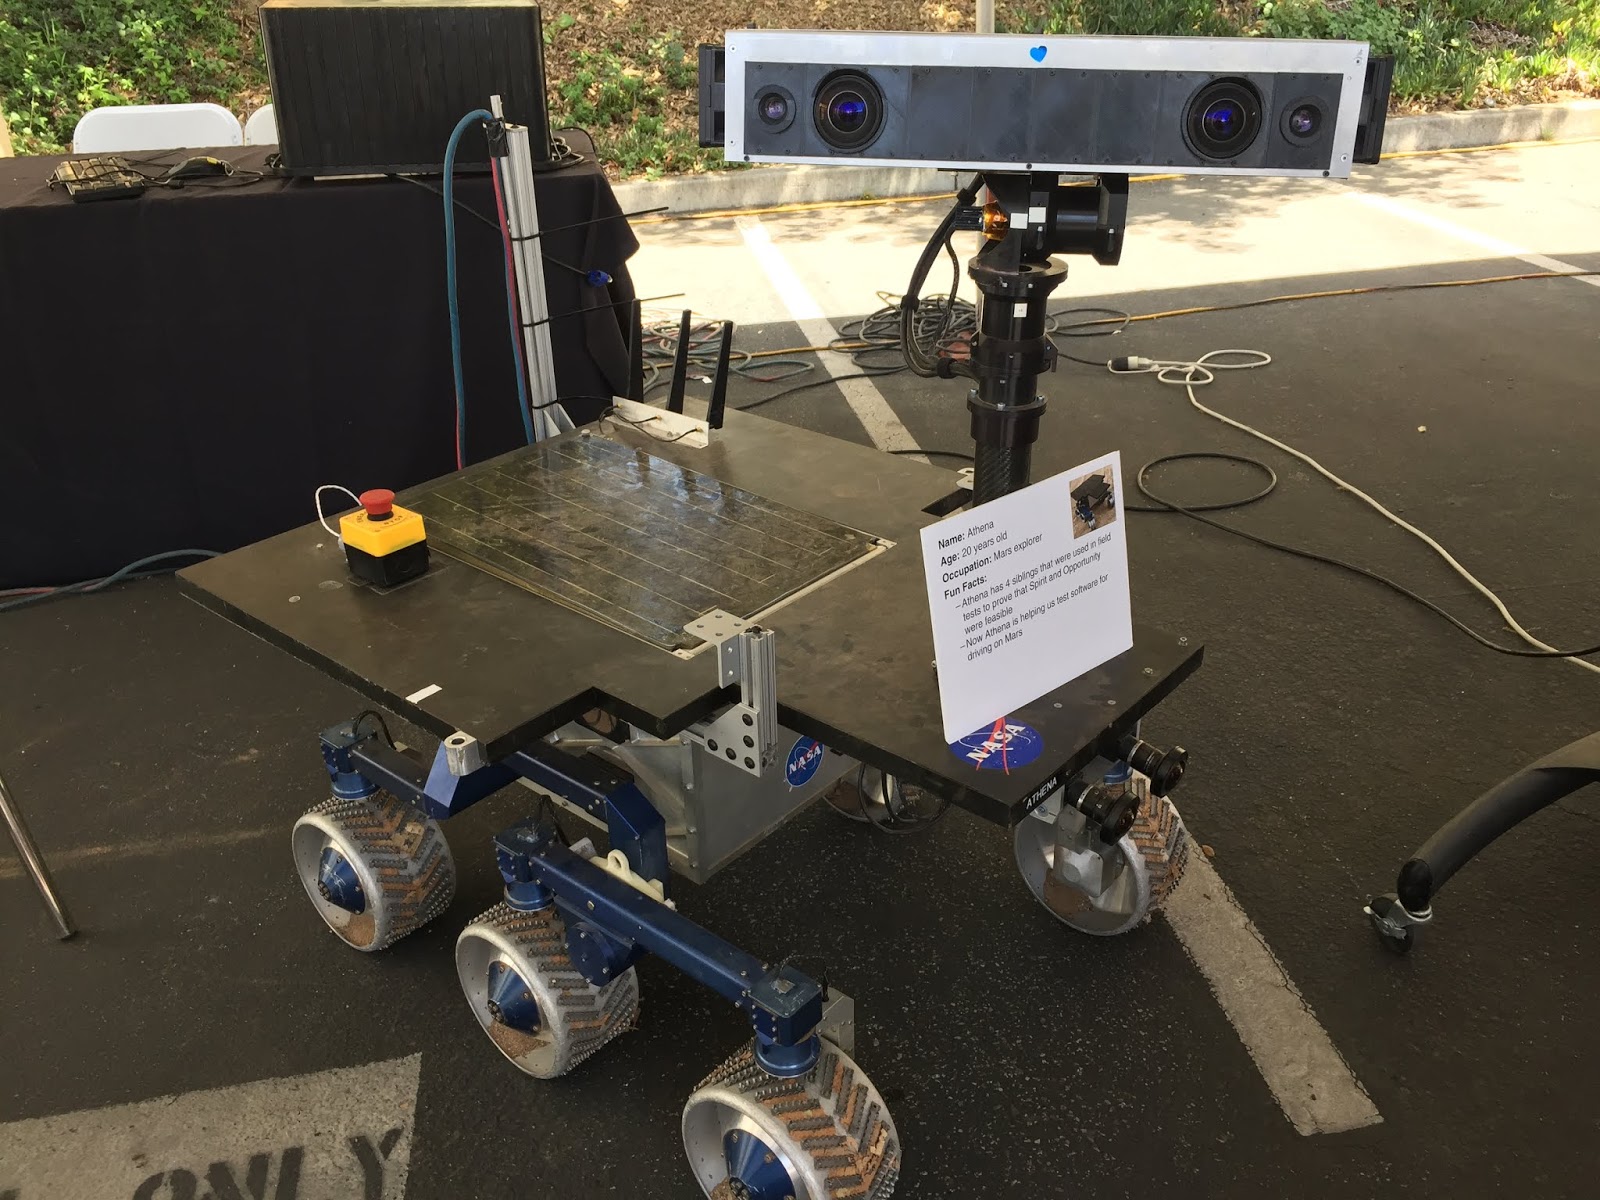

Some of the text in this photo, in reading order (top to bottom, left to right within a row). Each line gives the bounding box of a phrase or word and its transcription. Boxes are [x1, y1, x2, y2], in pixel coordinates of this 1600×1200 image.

[938, 520, 994, 550] Name: Athena
[940, 530, 1008, 567] Age: 20 years old
[942, 534, 1042, 583] Occupation: Mars explorer
[990, 583, 1003, 595] has
[1005, 579, 1010, 587] 4
[1012, 567, 1038, 585] siblings
[1040, 560, 1053, 572] that
[1055, 551, 1071, 566] were
[1073, 541, 1089, 557] used
[1097, 532, 1112, 546] field
[944, 575, 987, 600] Fun Facts:
[963, 551, 1101, 622] tests to prove that Spirit and Opportunity
[964, 605, 1013, 635] were feasible
[985, 622, 1011, 639] Athena
[1012, 616, 1018, 625] is
[1020, 604, 1046, 622] helping
[1047, 599, 1056, 609] us
[1056, 592, 1069, 605] test
[1070, 579, 1098, 598] software
[1099, 573, 1109, 584] for
[967, 629, 1023, 661] driving on Mars
[789, 745, 821, 774] NASA
[966, 724, 1026, 763] NASA
[1026, 776, 1057, 810] ATHENA
